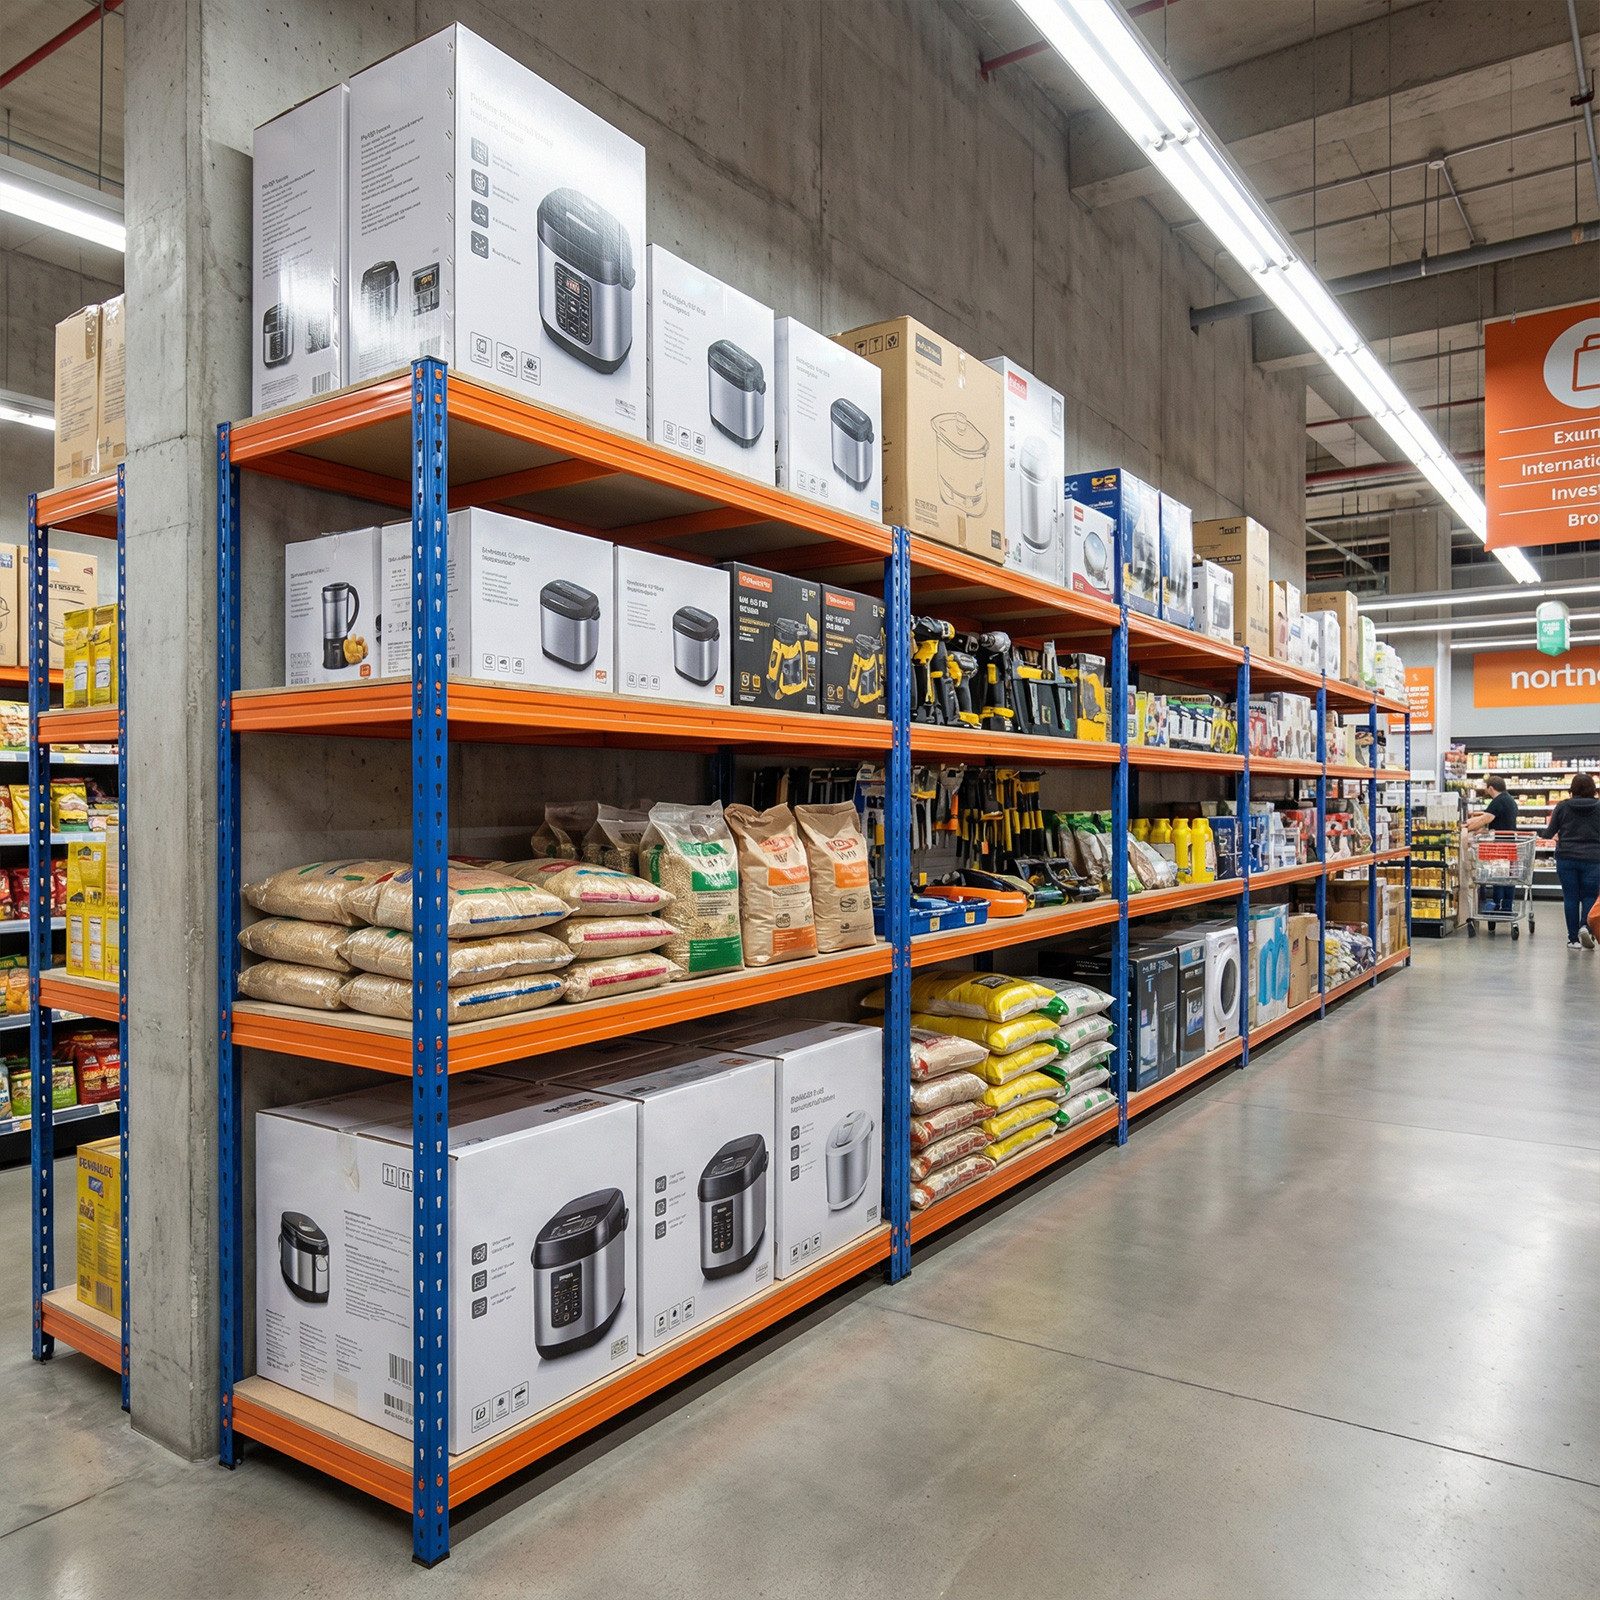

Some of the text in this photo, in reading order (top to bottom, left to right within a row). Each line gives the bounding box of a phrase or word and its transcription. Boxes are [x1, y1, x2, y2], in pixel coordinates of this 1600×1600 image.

[1552, 484, 1600, 500] Inves
[1568, 513, 1600, 527] Bro
[1511, 663, 1600, 689] nortn
